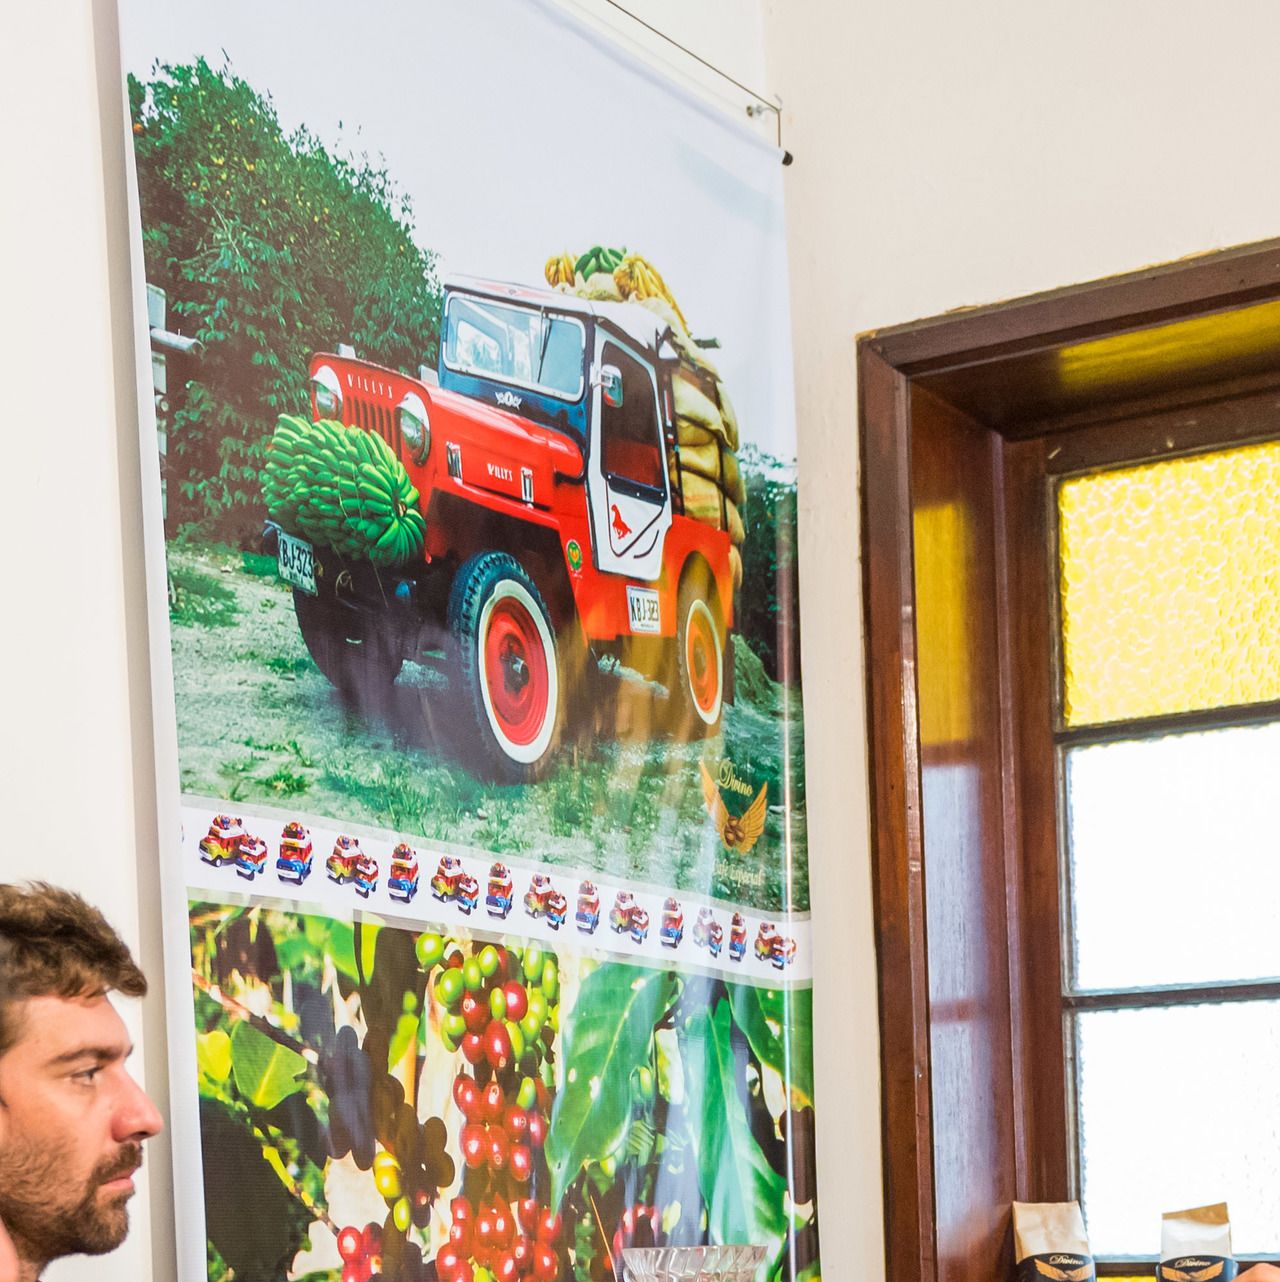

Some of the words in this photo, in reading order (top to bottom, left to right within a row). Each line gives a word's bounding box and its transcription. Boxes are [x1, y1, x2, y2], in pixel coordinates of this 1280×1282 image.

[719, 758, 754, 797] Divino
[1048, 1254, 1085, 1265] Divino
[1174, 1257, 1212, 1269] Divino
